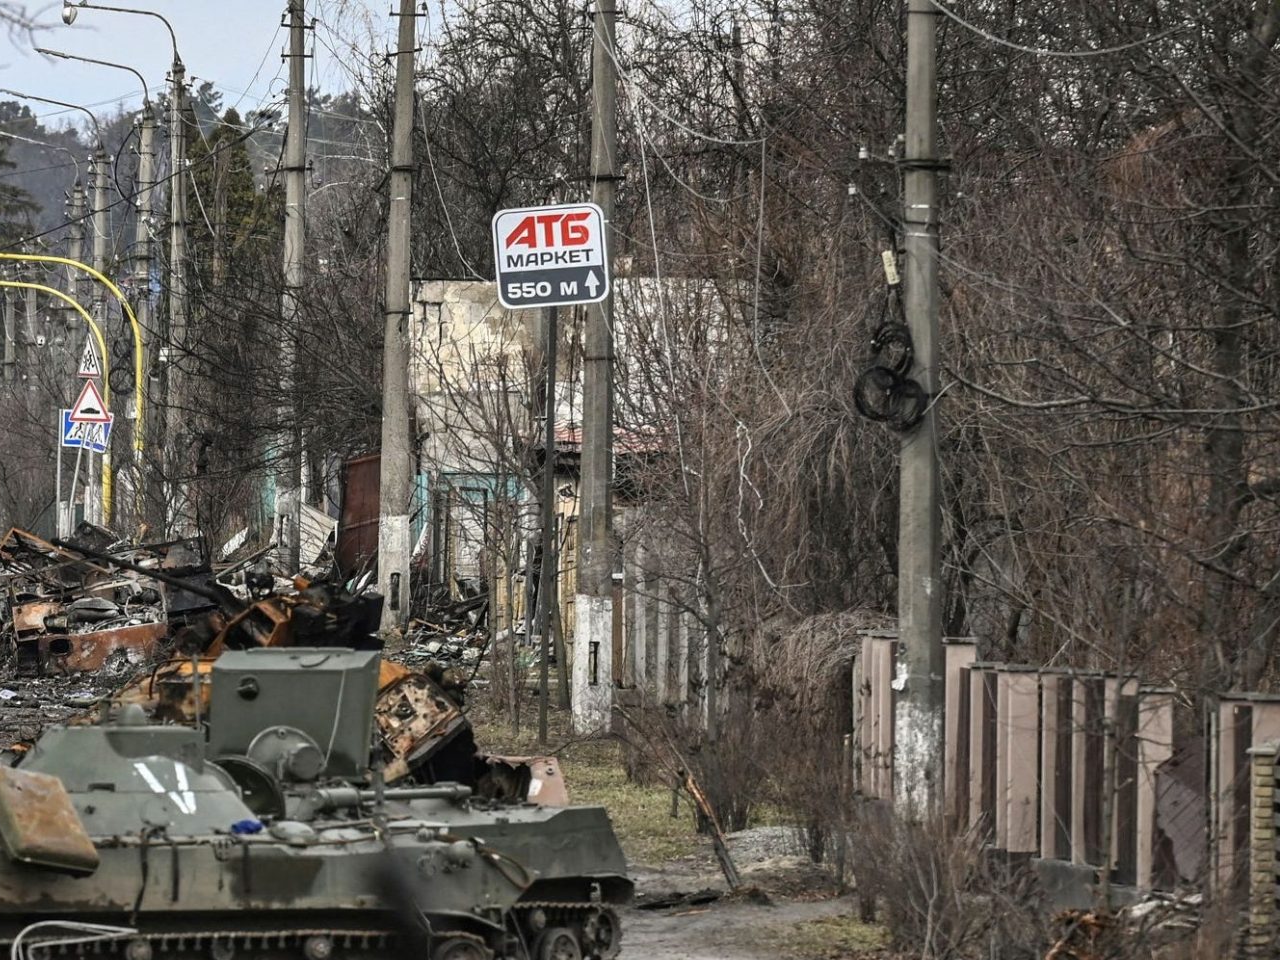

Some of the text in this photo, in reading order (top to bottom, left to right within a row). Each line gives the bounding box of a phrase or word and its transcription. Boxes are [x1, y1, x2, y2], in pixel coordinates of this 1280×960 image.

[505, 212, 592, 250] АТБ
[506, 248, 594, 268] МАРКЕТ
[507, 281, 552, 299] 550
